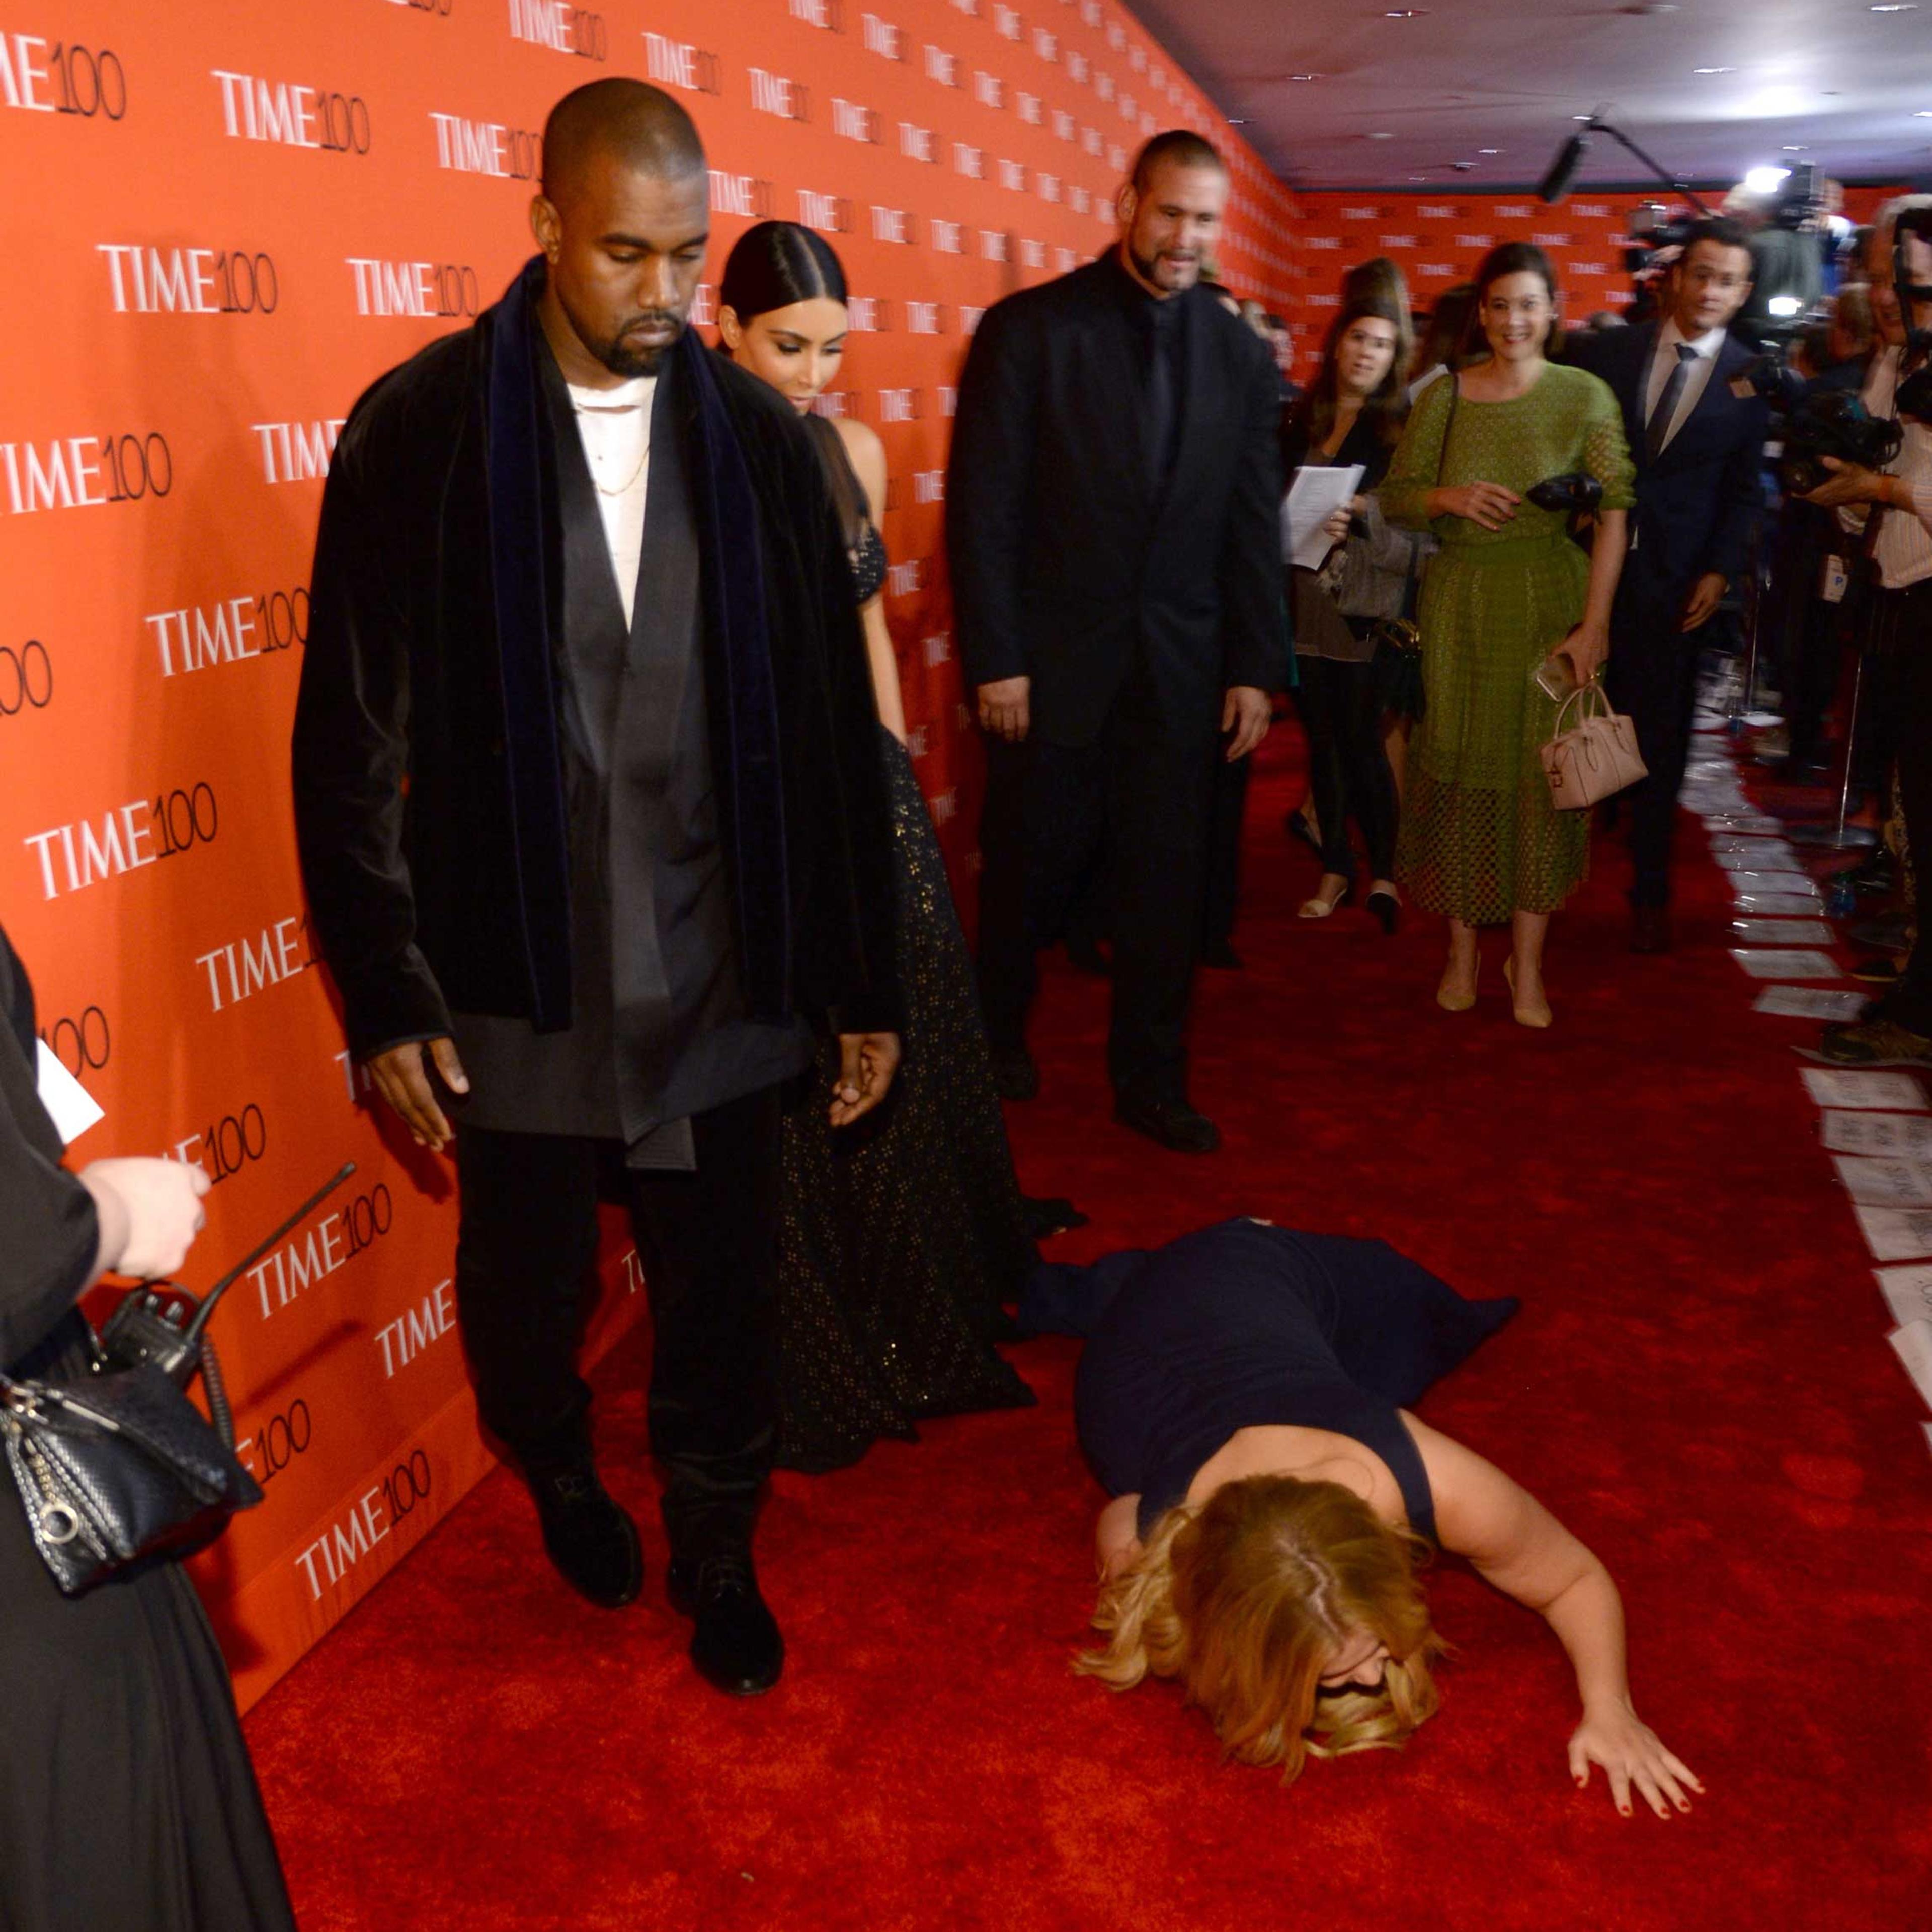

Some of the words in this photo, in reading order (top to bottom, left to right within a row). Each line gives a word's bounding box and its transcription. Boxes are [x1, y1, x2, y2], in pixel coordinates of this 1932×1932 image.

[210, 69, 370, 155] TIME100
[96, 244, 278, 315] TIME100
[345, 258, 478, 318] TIME100
[24, 781, 217, 901] TIME100
[247, 1184, 392, 1319] TIME100
[294, 1449, 432, 1601] TIME100
